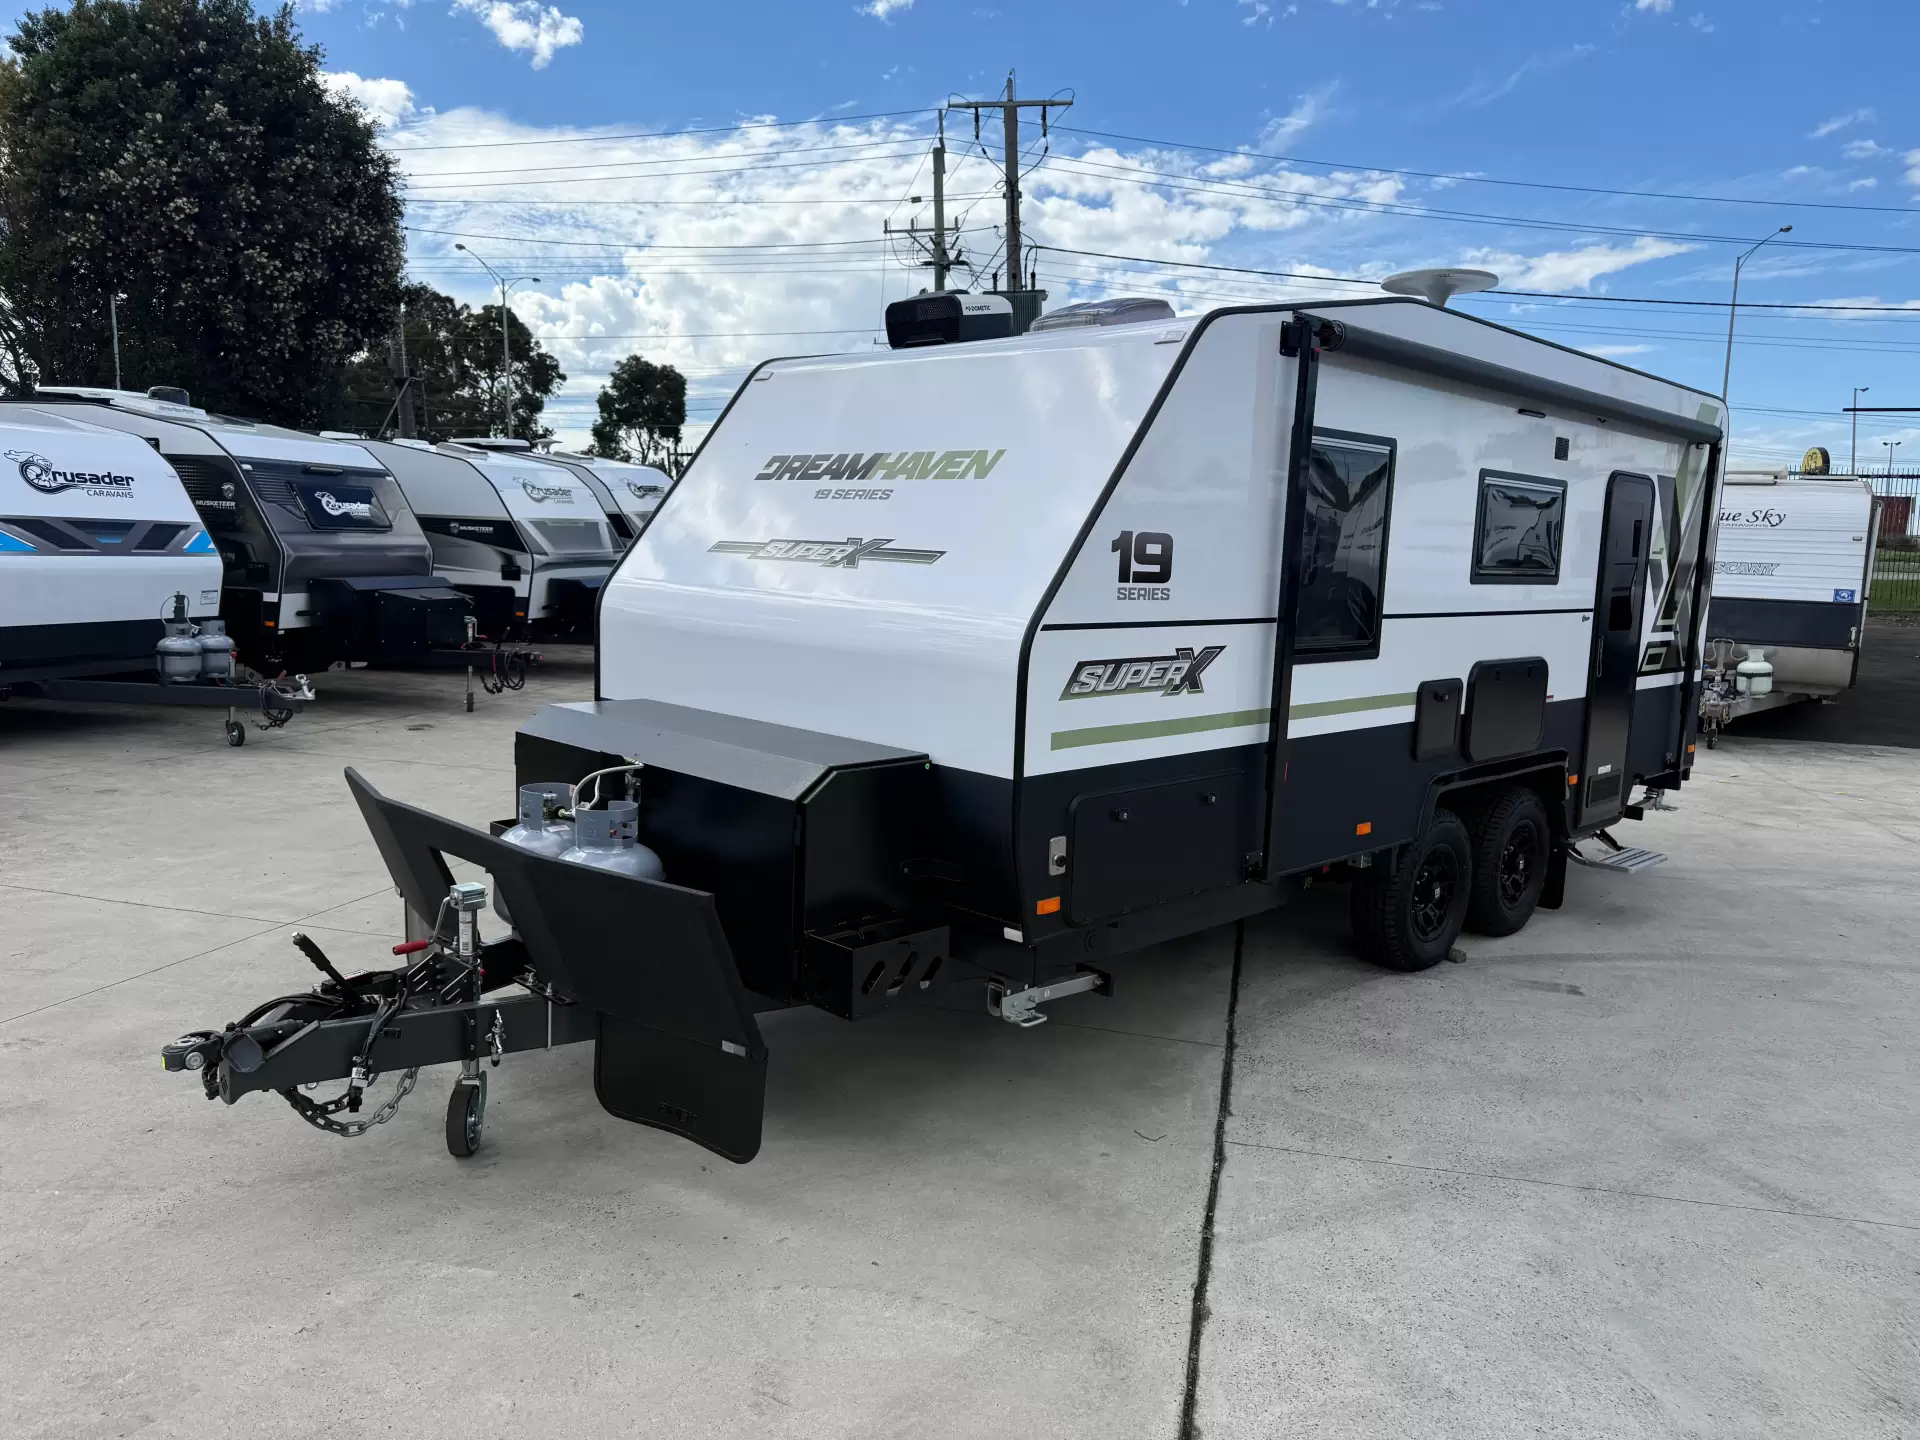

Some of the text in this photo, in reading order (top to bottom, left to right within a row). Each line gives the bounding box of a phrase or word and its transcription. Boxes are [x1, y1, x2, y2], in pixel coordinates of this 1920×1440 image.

[753, 449, 1007, 481] DREAMHAVEN
[19, 460, 135, 495] Crusader
[87, 489, 135, 499] CARAVANS
[813, 488, 894, 501] 19 SERIES
[1745, 508, 1787, 528] Sky
[1110, 530, 1174, 584] 19
[1116, 587, 1171, 601] SERIES
